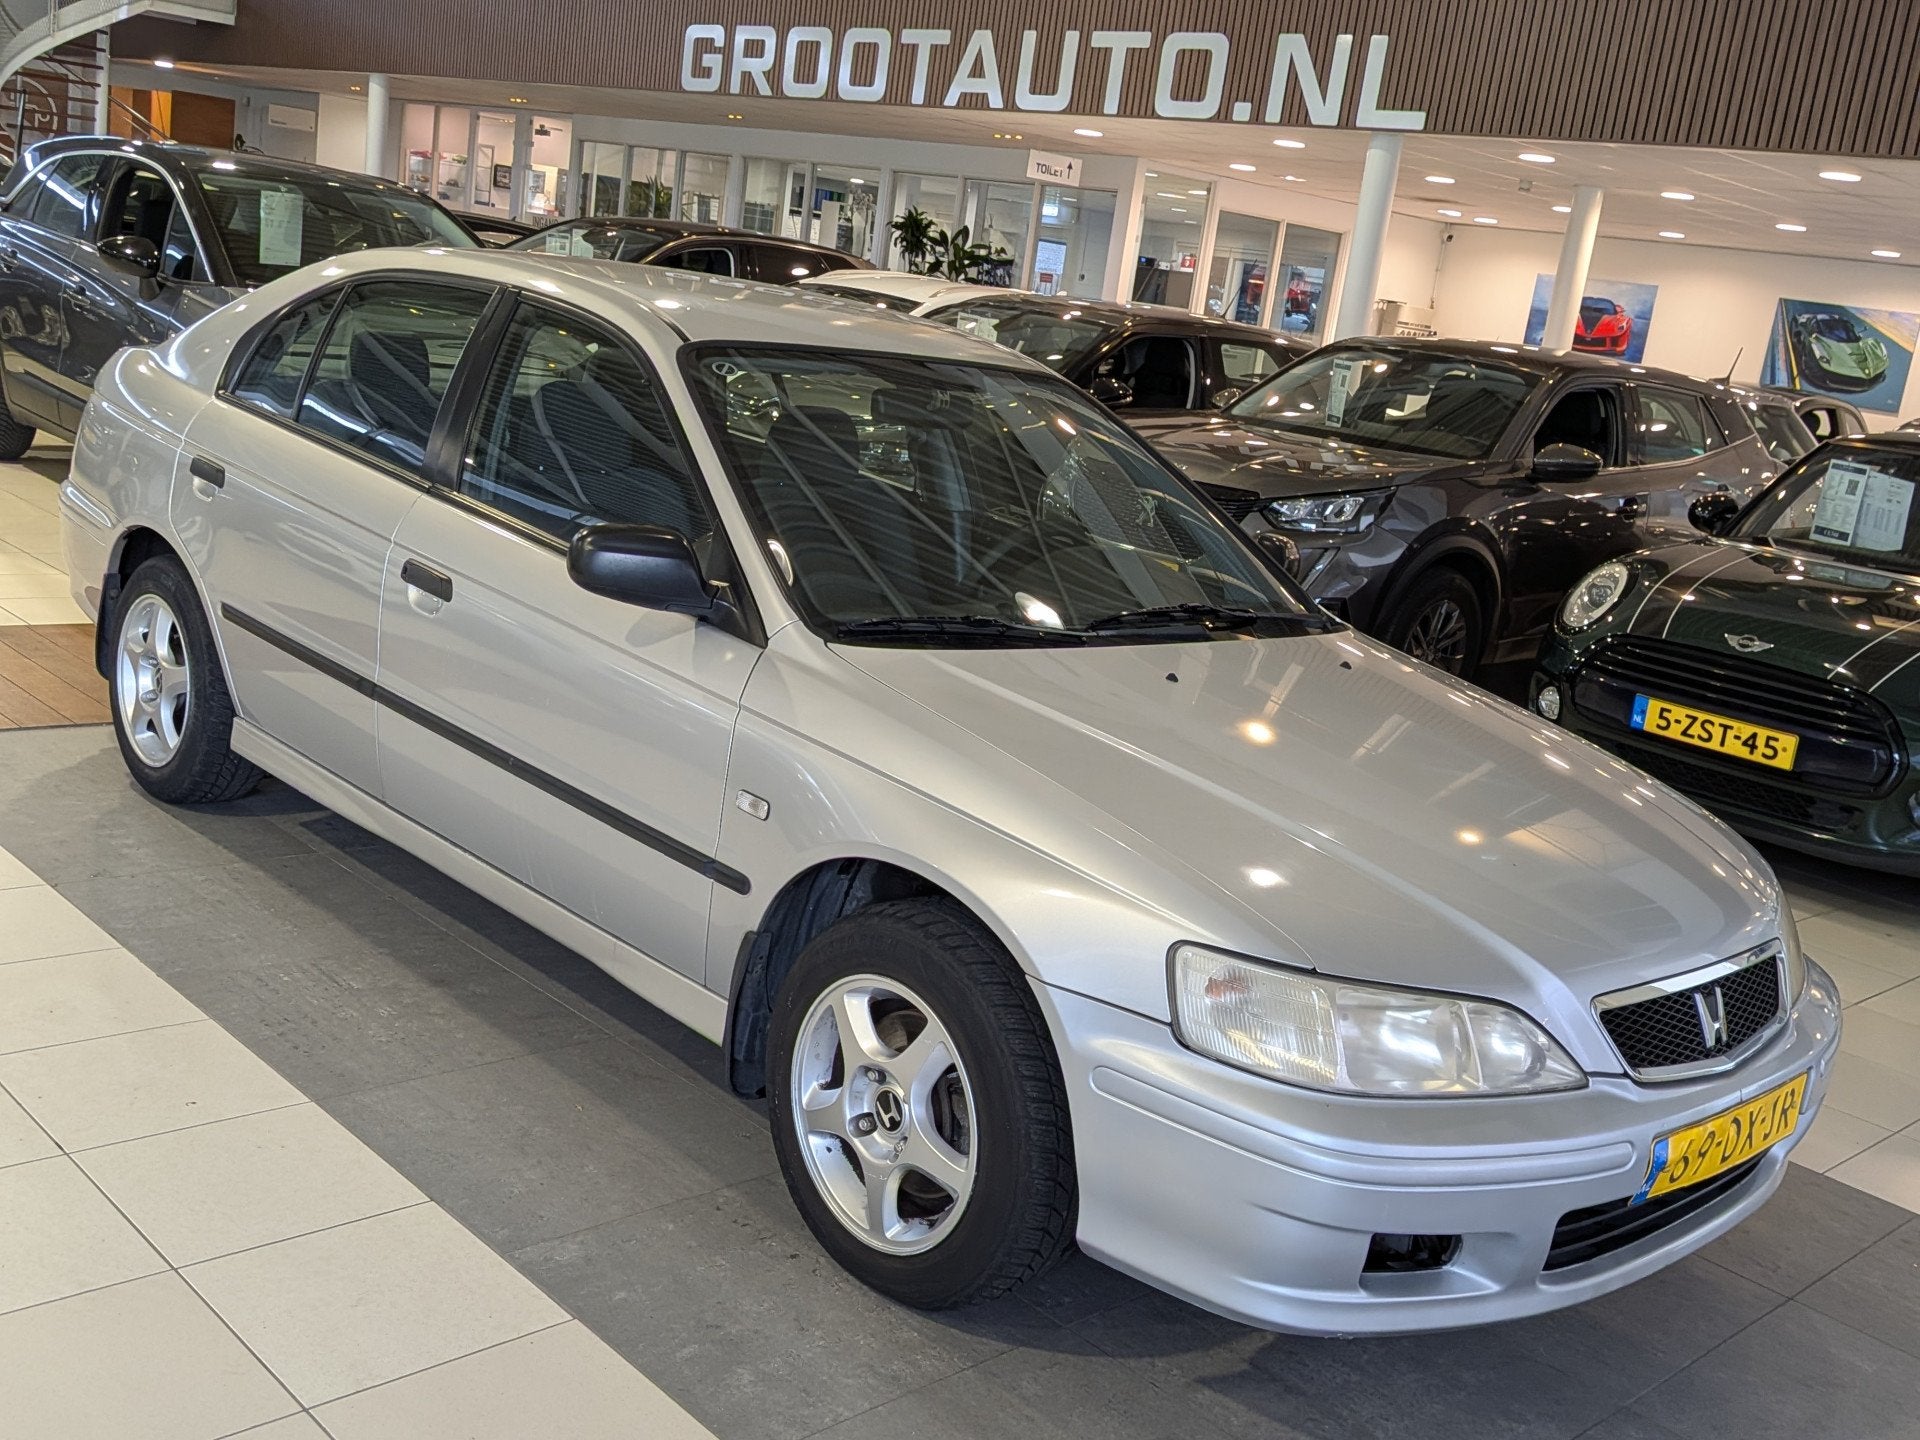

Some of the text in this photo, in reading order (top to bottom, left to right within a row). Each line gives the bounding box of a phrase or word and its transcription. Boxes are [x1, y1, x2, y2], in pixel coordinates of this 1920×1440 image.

[681, 24, 1427, 131] GROOTAUTO.NL
[1036, 162, 1063, 178] TOILET
[1633, 706, 1780, 761] NL 5-ZST-45
[1669, 1088, 1796, 1184] 69-DX-JR
